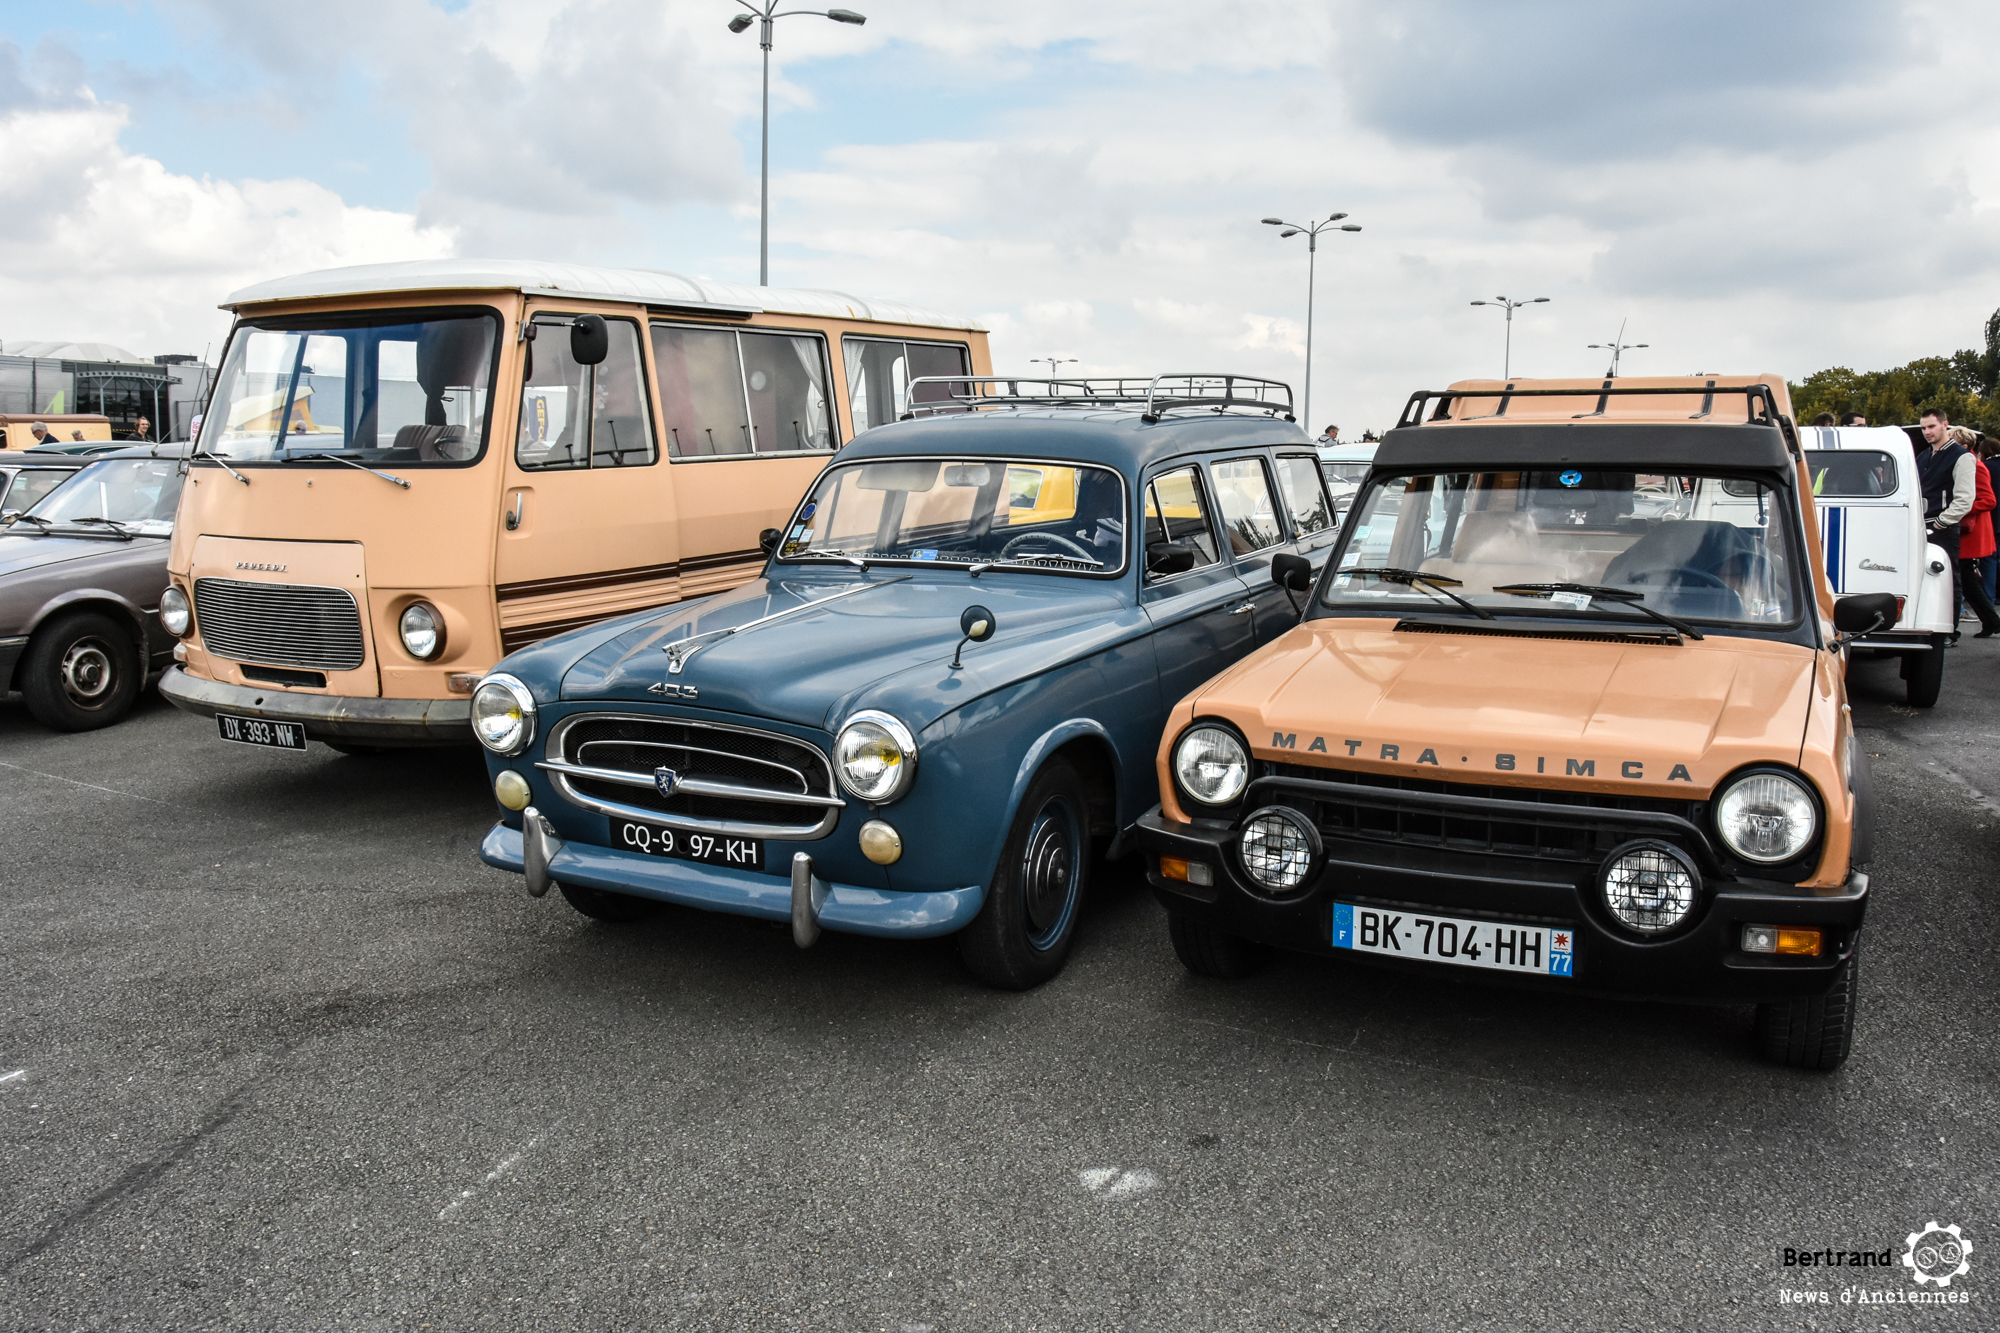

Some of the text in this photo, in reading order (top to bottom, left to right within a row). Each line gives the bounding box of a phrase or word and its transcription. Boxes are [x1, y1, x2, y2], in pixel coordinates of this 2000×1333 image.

[235, 560, 288, 573] PEUGEOT
[647, 682, 699, 700] 403
[1495, 753, 1693, 782] SIMCA
[1339, 930, 1347, 940] F
[1360, 911, 1542, 968] BK-704-HH
[1550, 953, 1572, 973] 77
